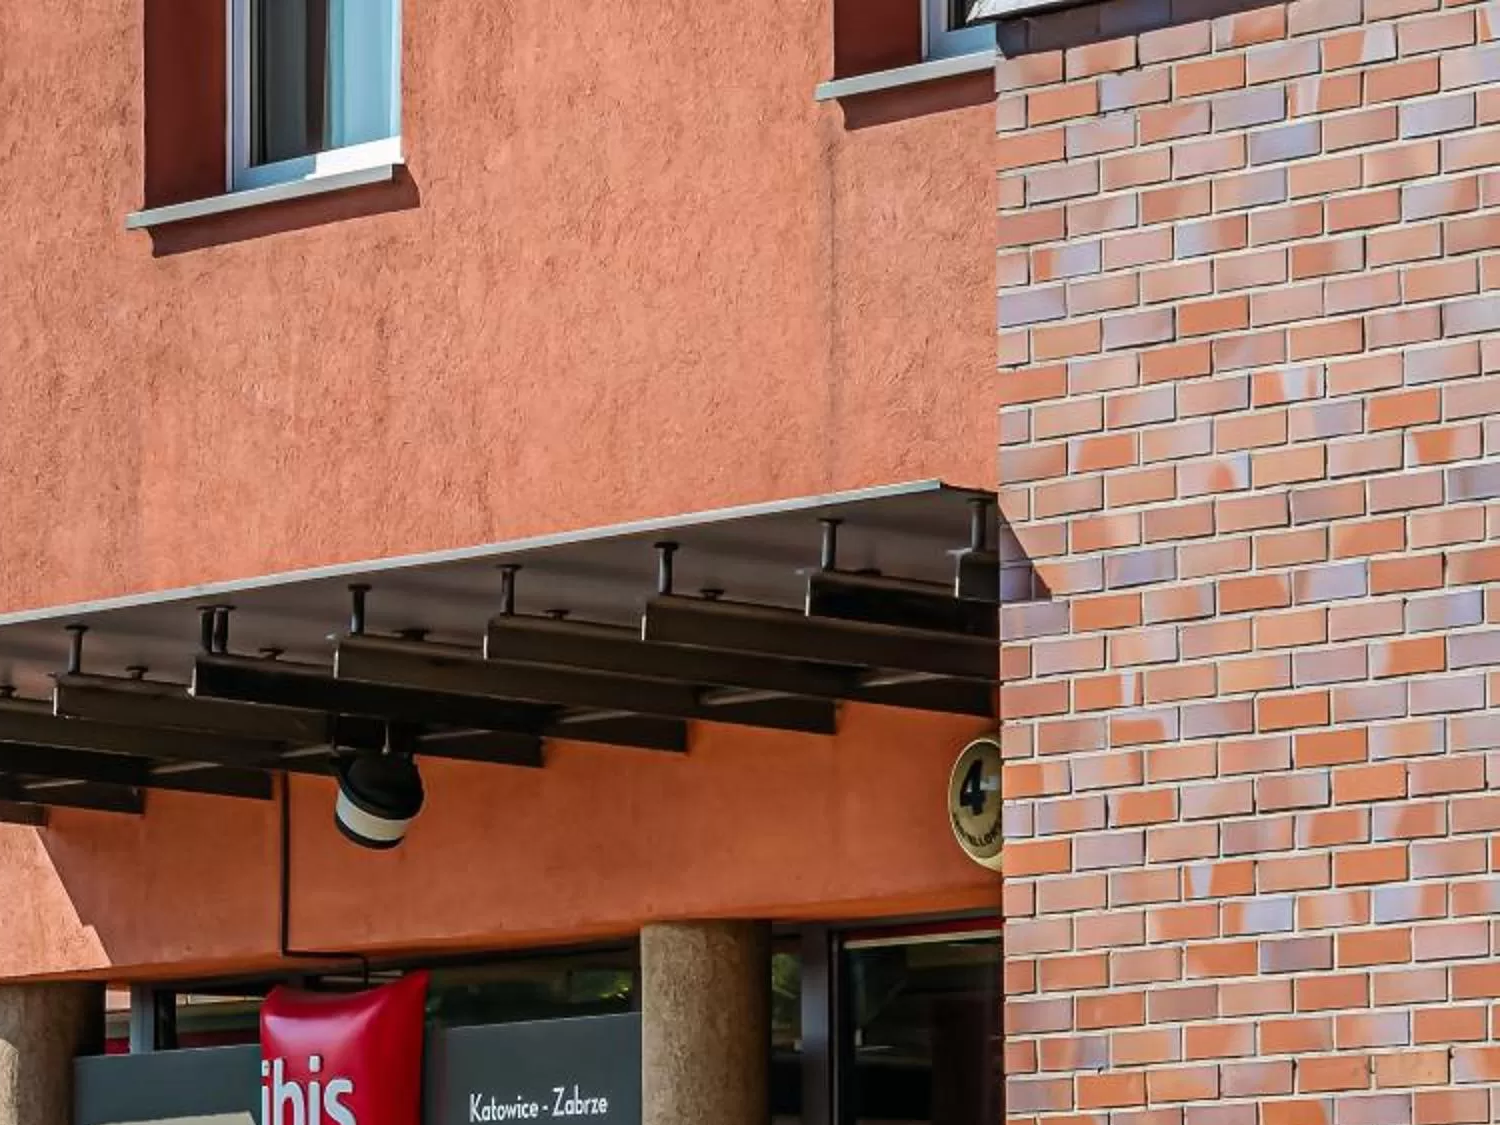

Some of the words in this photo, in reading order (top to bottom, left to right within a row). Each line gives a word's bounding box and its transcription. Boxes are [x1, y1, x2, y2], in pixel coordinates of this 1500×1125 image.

[959, 759, 987, 816] 4
[469, 1093, 539, 1123] Katowice
[551, 1084, 609, 1117] Zabrze
